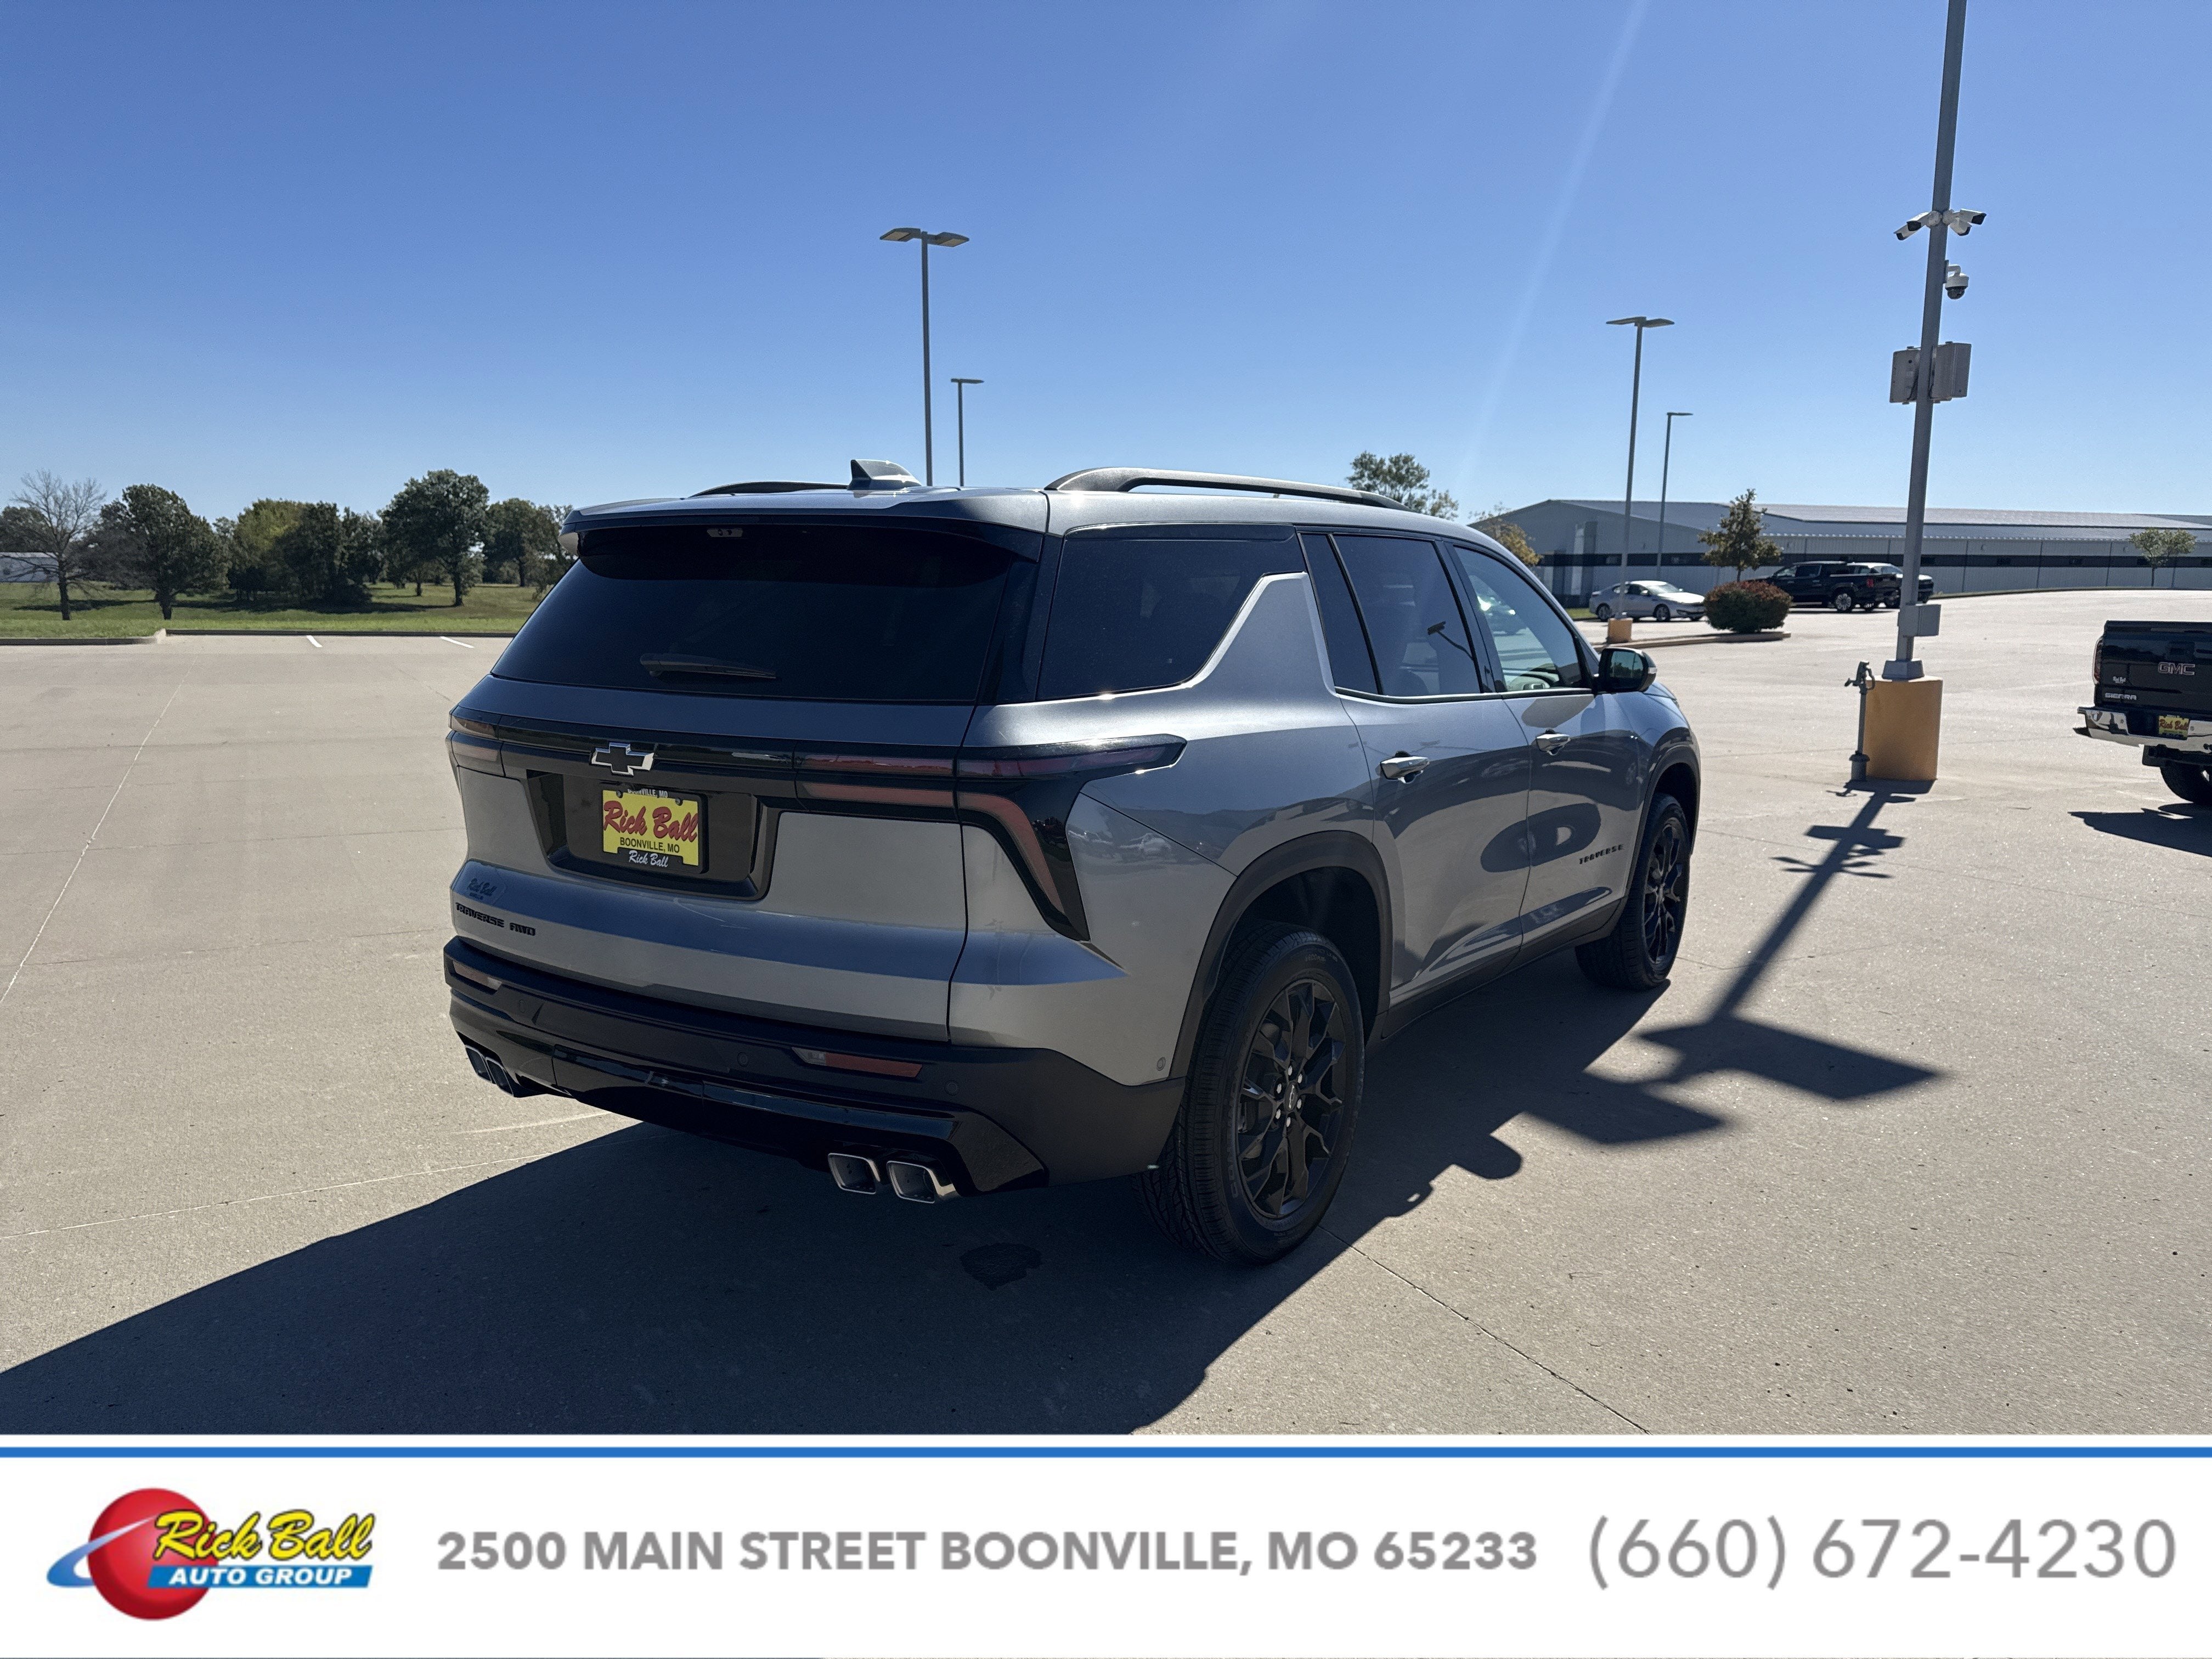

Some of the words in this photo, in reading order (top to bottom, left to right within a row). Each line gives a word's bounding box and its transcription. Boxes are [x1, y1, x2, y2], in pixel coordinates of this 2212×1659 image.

[2159, 662, 2195, 675] GMC
[2105, 692, 2137, 701] SIERRA
[603, 800, 647, 836] Rick
[652, 806, 698, 842] Ball
[620, 837, 665, 853] BOONVILLE,
[667, 843, 680, 853] MO
[629, 850, 648, 865] Rick
[650, 853, 668, 868] Ball
[455, 902, 505, 928] TRAVERSE
[510, 922, 536, 936] AWD
